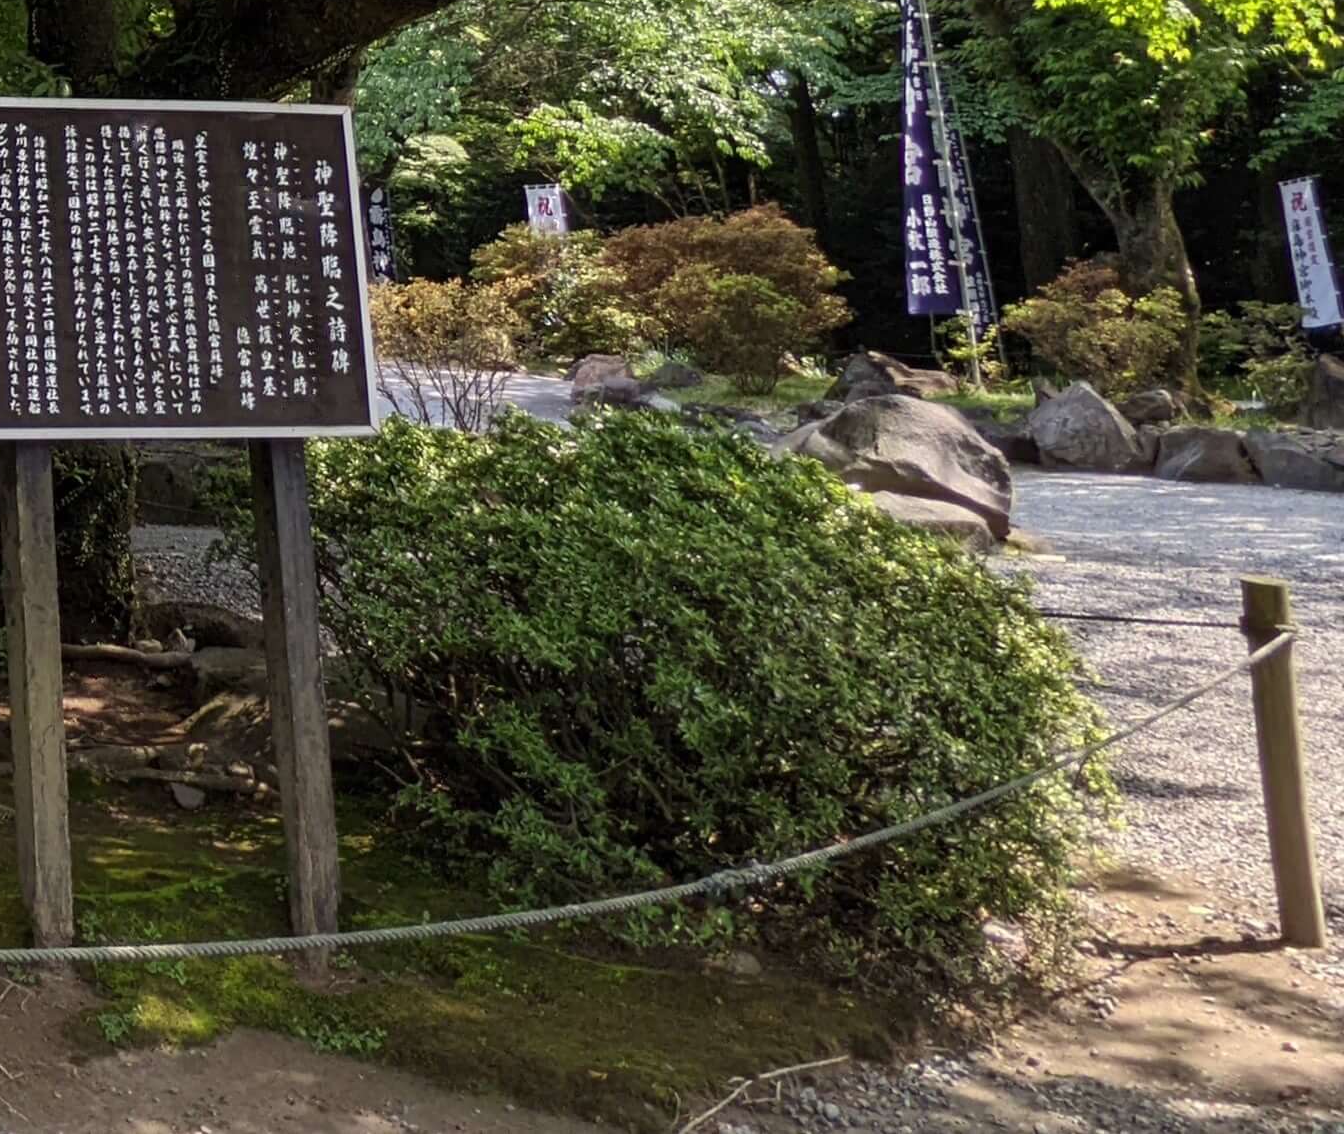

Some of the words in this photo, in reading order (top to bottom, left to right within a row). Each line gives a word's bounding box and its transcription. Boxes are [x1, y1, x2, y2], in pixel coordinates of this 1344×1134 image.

[273, 141, 298, 260] 神聖降臨地
[314, 159, 350, 375] 神聖降臨之詩碑
[236, 326, 257, 411] 徳富蘇峰
[285, 273, 308, 396] 乾坤定位時
